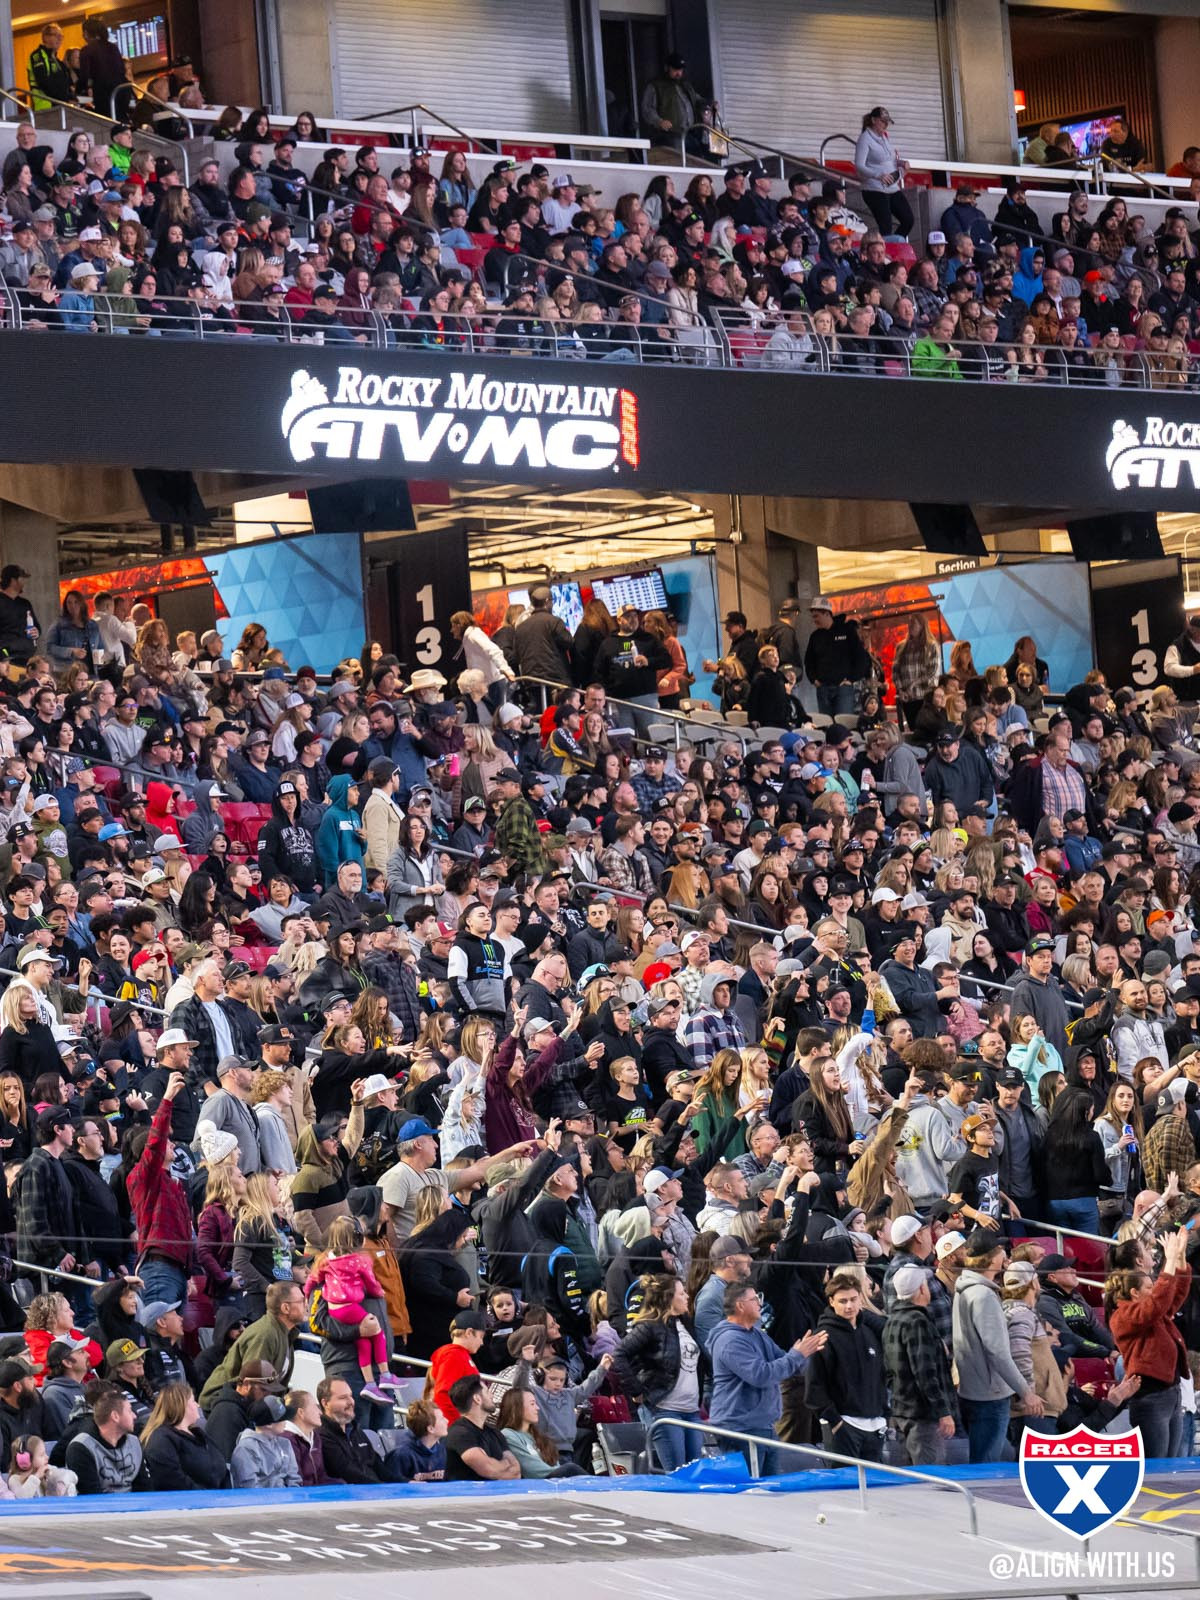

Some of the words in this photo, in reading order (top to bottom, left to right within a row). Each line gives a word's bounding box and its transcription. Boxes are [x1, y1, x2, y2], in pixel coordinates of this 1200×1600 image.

[334, 366, 442, 408] ROCKY
[444, 373, 618, 417] MOUNTAIN
[938, 559, 976, 575] Section
[102, 1528, 325, 1549] UTAH
[336, 1513, 625, 1537] SPORTS
[177, 1527, 692, 1563] COMMISSION
